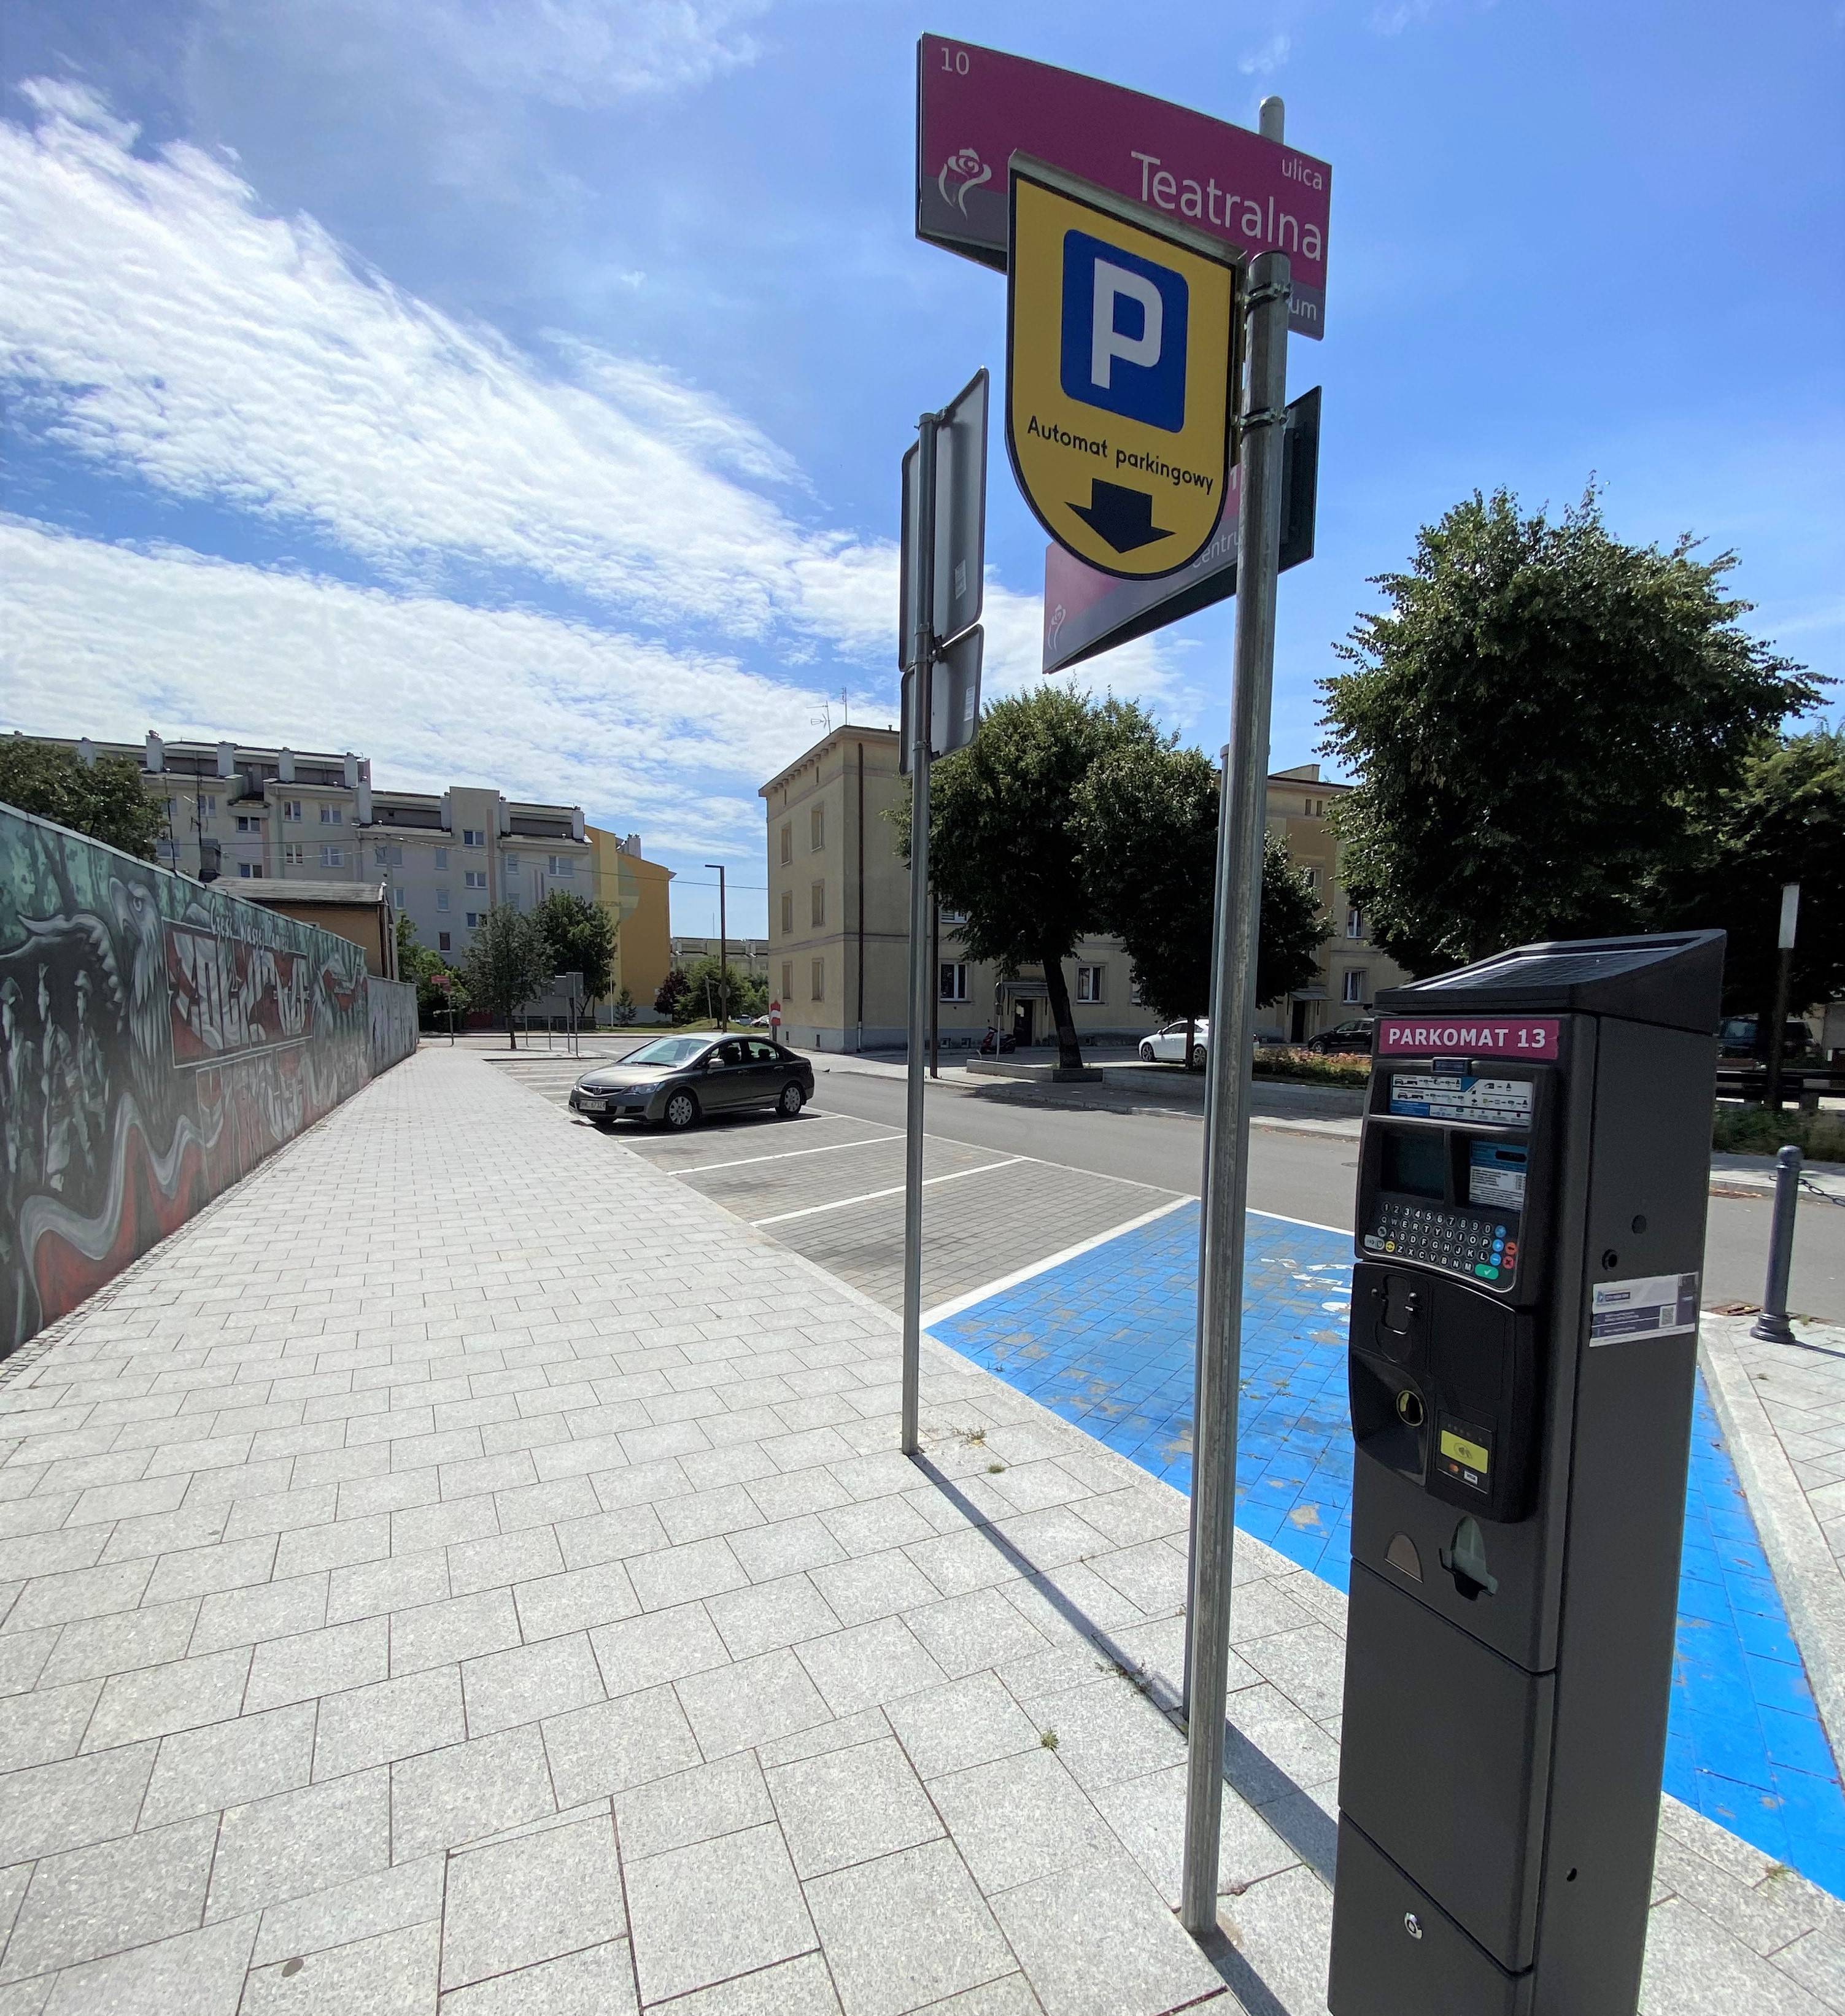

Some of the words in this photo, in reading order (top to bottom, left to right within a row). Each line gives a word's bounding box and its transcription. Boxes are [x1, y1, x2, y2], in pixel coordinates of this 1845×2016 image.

[940, 47, 970, 75] 10
[1282, 158, 1322, 190] ulica
[1131, 150, 1321, 261] Teatralna
[1091, 257, 1164, 390] P
[1027, 415, 1108, 458] Automat
[1115, 449, 1213, 496] parkingowy
[1388, 1028, 1509, 1046] PARKOMAT
[1517, 1029, 1545, 1048] 13
[1426, 1212, 1431, 1221] 5
[1473, 1222, 1478, 1230] 9
